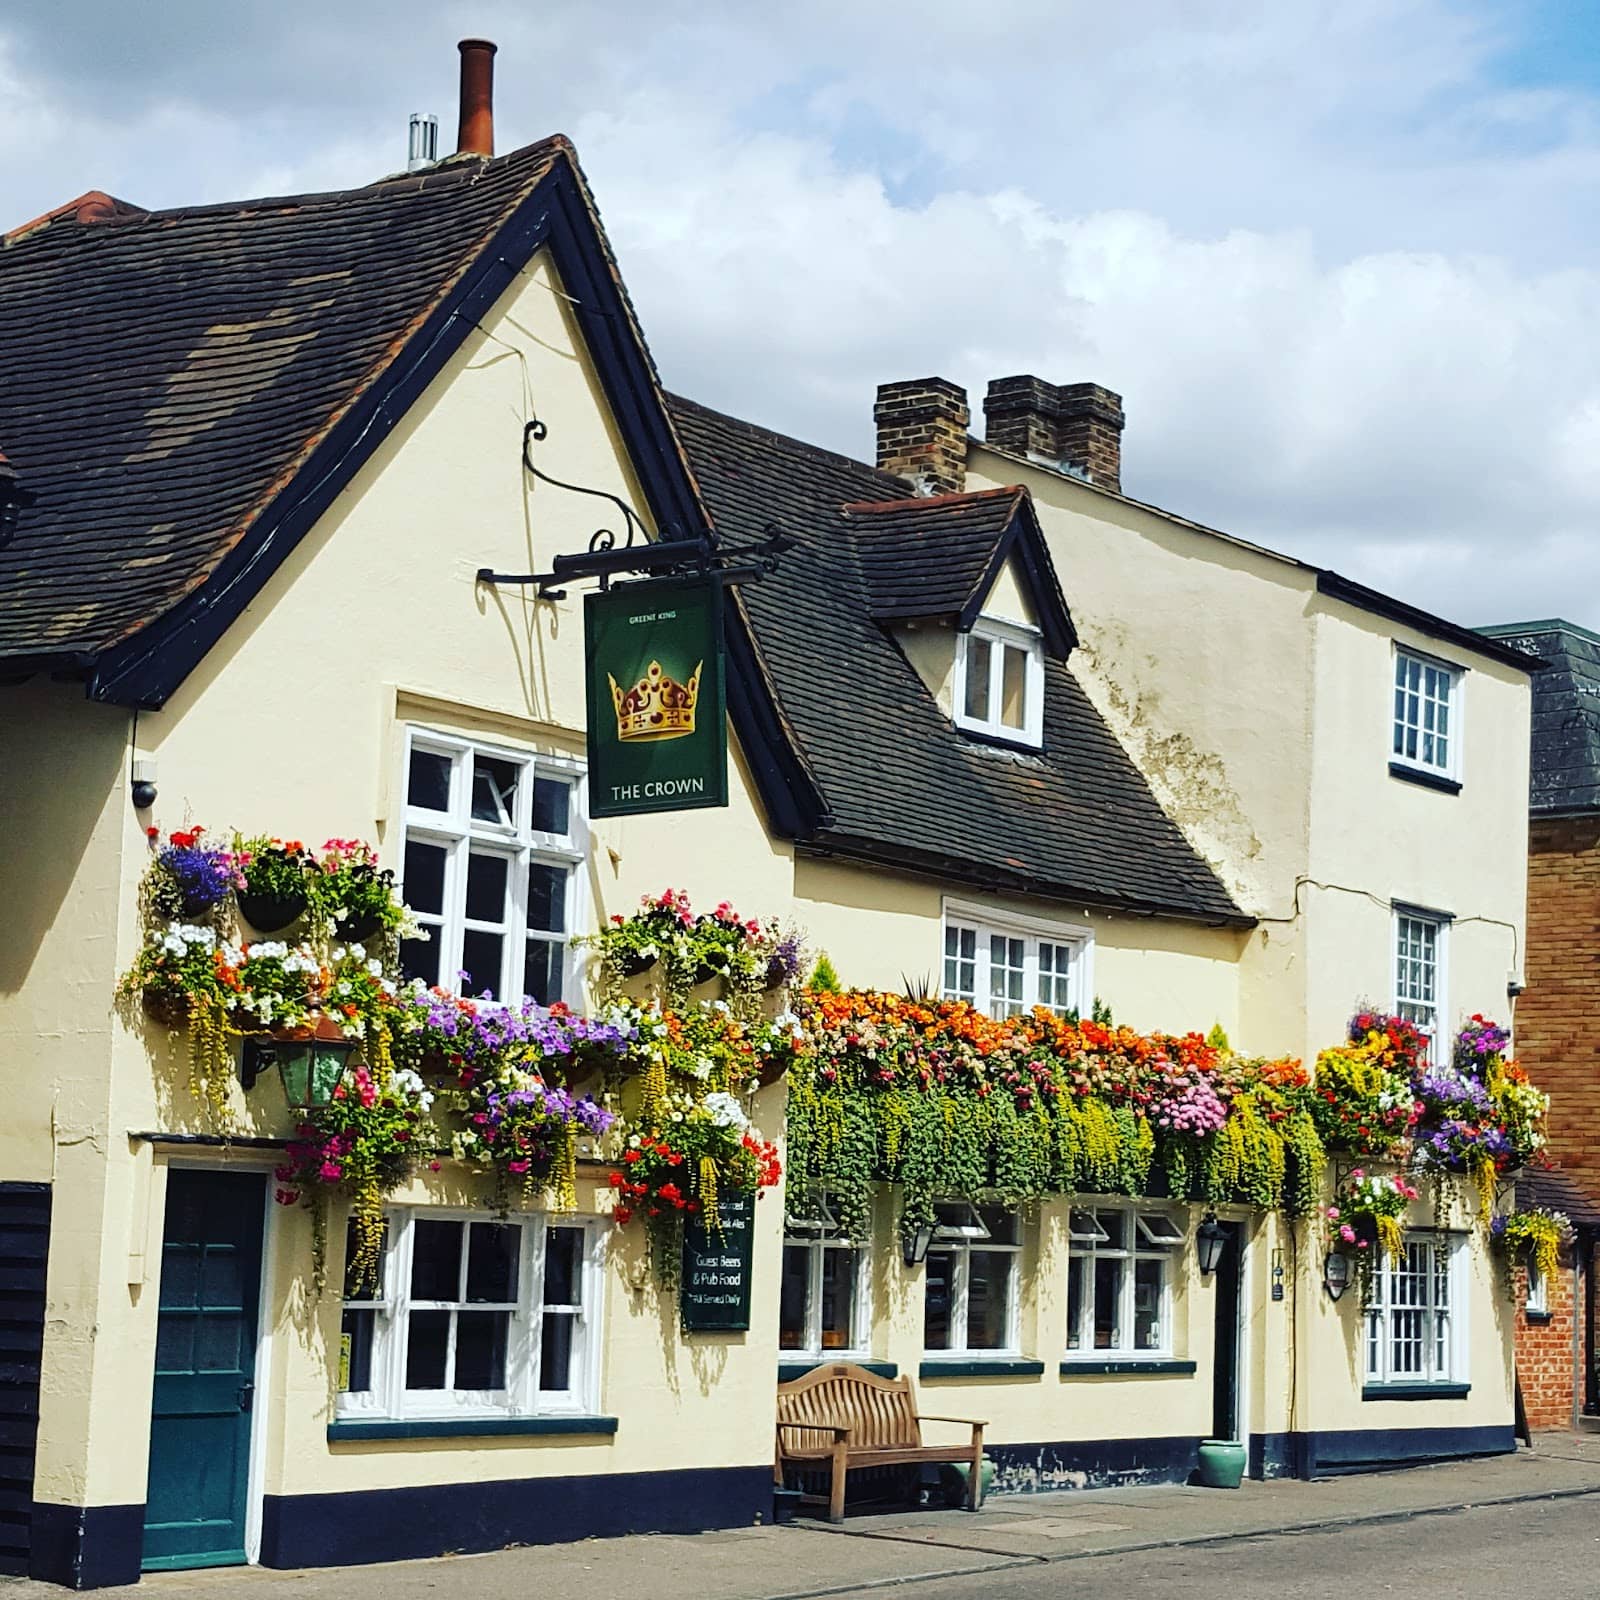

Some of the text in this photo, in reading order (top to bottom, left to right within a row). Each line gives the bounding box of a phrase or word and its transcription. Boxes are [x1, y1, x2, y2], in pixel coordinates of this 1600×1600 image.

[629, 610, 677, 625] GREENE KING
[611, 777, 704, 801] THE CROWN
[696, 1254, 741, 1268] Guest Beers
[693, 1272, 741, 1286] & Pub Food
[725, 1294, 741, 1306] Daily
